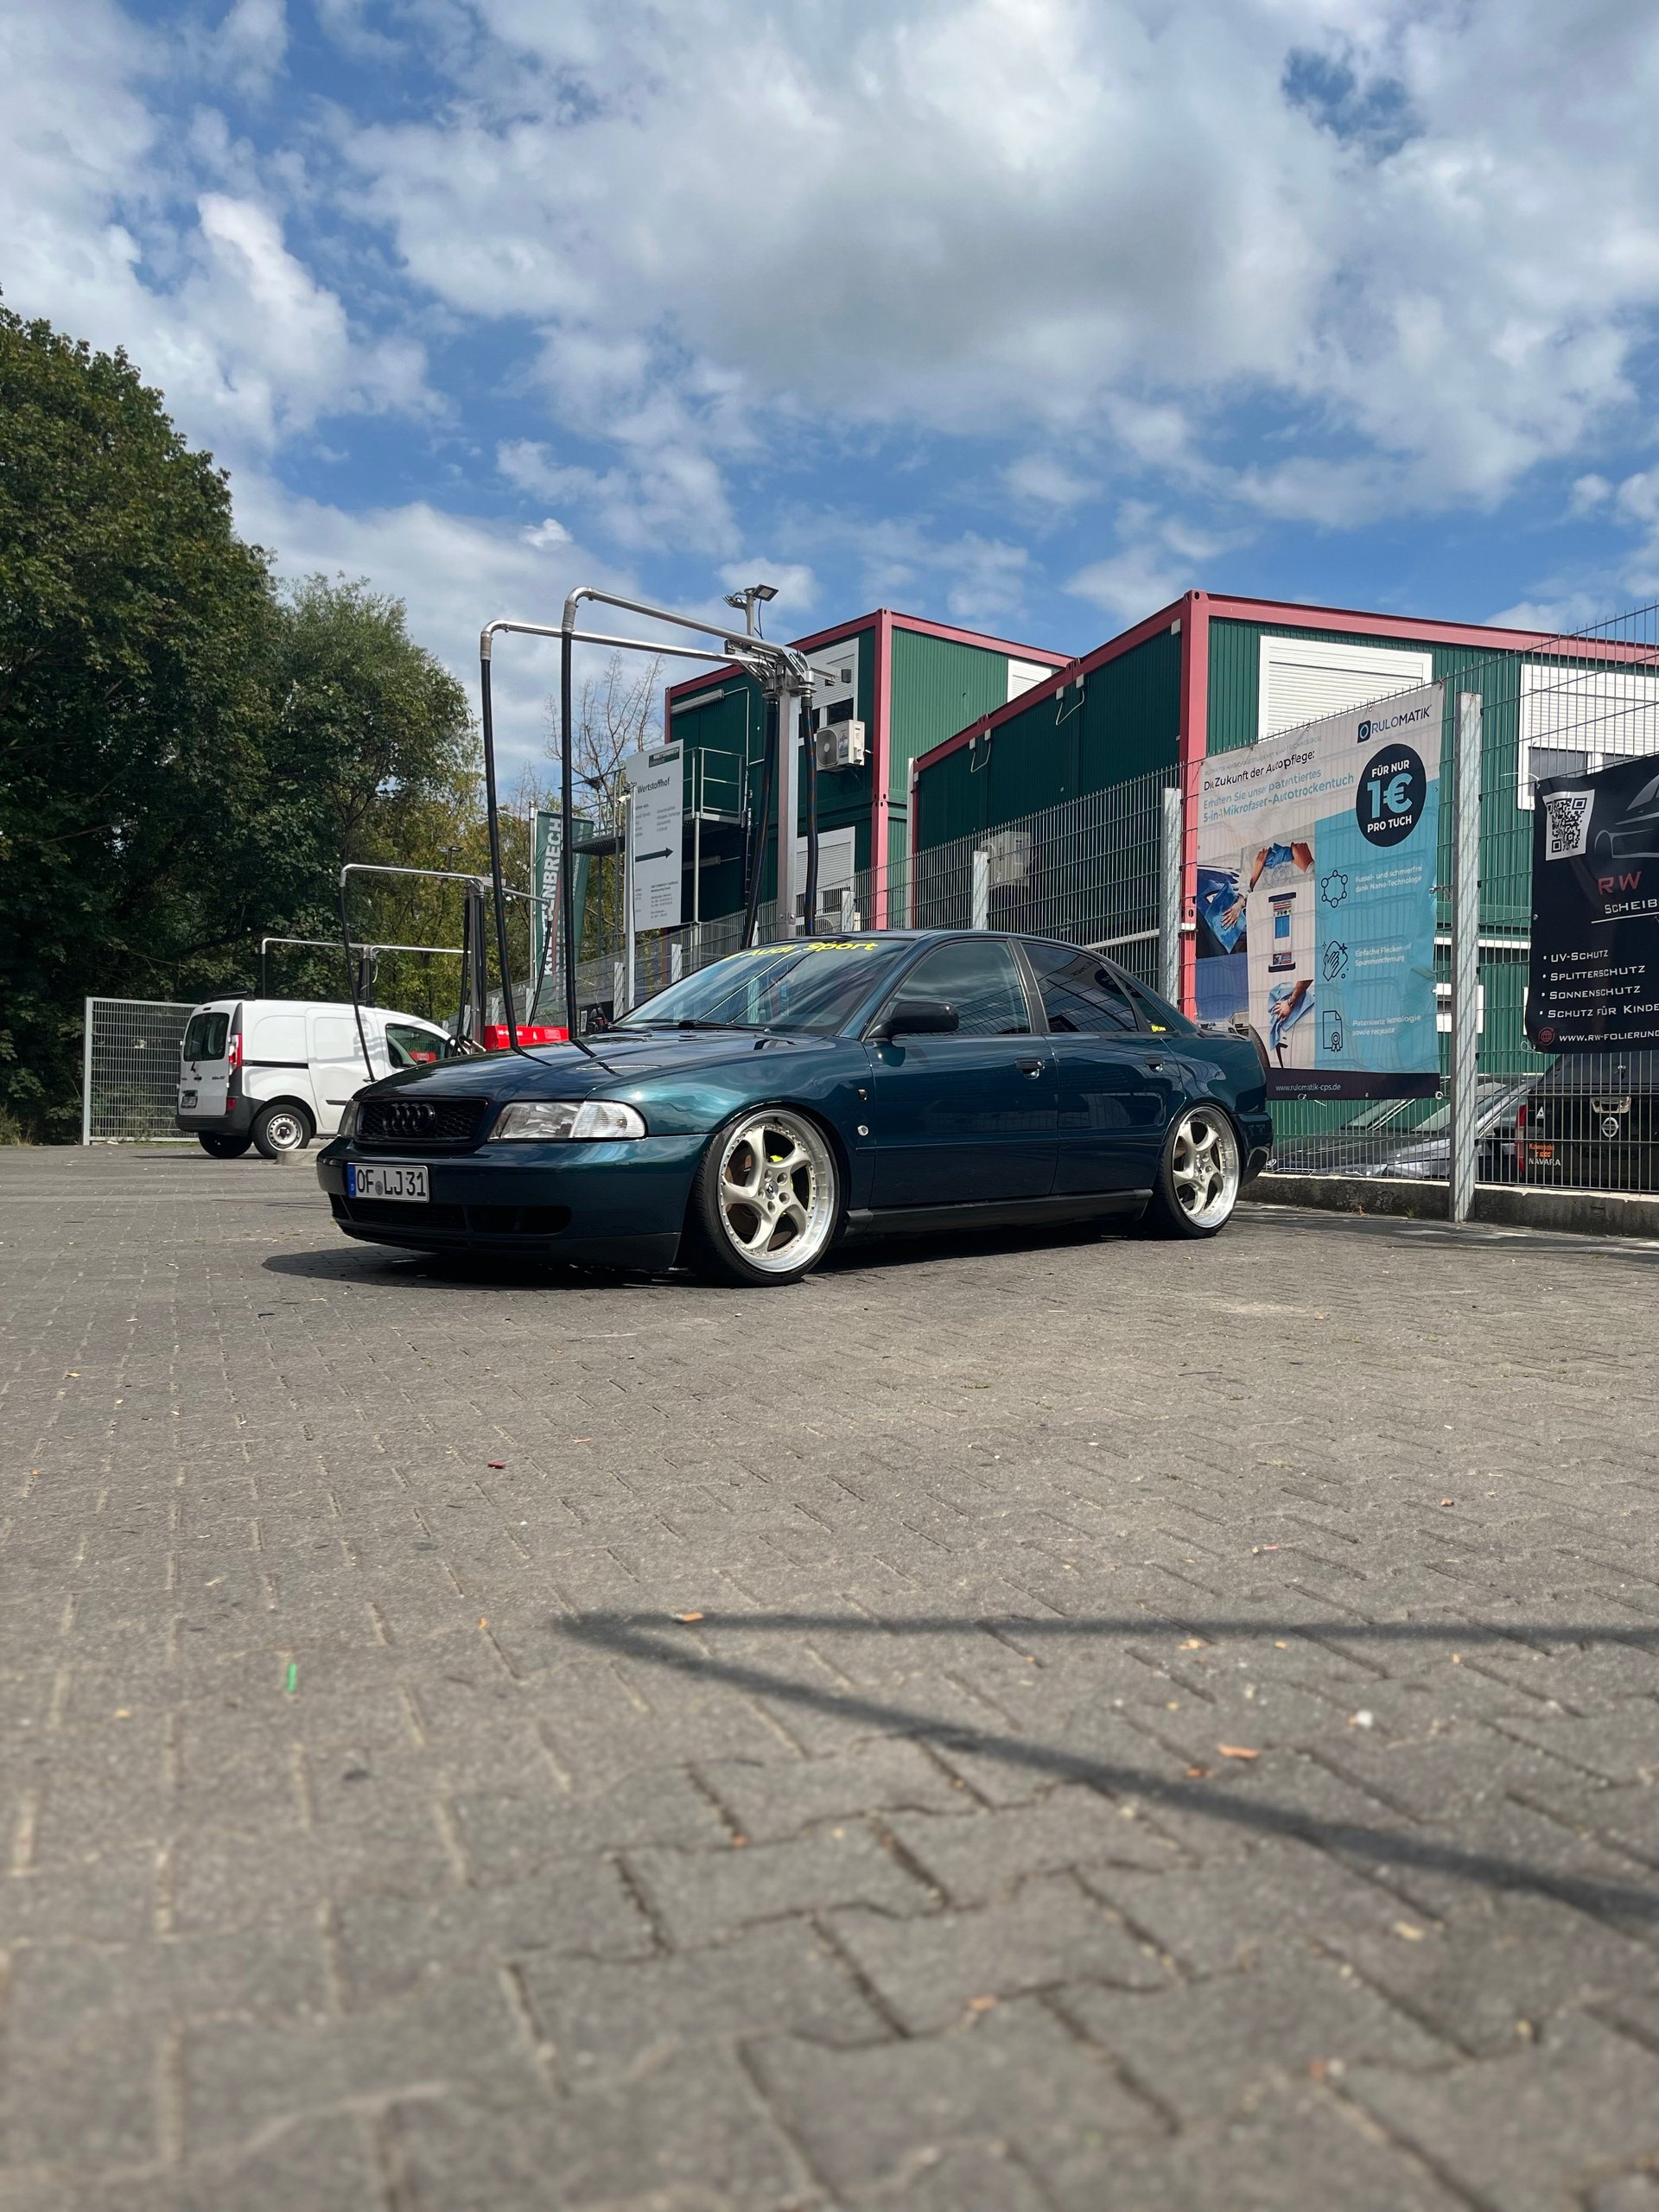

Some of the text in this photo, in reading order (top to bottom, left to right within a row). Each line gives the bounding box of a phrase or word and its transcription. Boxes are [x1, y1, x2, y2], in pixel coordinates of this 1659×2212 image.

[1371, 704, 1432, 734] RULOMATIK
[1215, 771, 1249, 787] Zukunft
[1250, 767, 1264, 779] der
[1266, 751, 1315, 773] Autopflege:
[1371, 760, 1409, 778] FÜR NUR
[637, 777, 671, 793] Wertstoffhof
[1234, 791, 1246, 802] Sie
[1268, 769, 1322, 793] patentiertes
[1367, 772, 1413, 819] 1€
[1367, 815, 1413, 833] PRO TUCH
[1376, 871, 1389, 880] und
[1598, 871, 1642, 895] RW
[741, 941, 878, 957] Audi Sport
[1275, 1083, 1341, 1092] www.rulomatik-cps.de
[1529, 1158, 1561, 1166] NAVARA
[357, 1169, 374, 1193] OF
